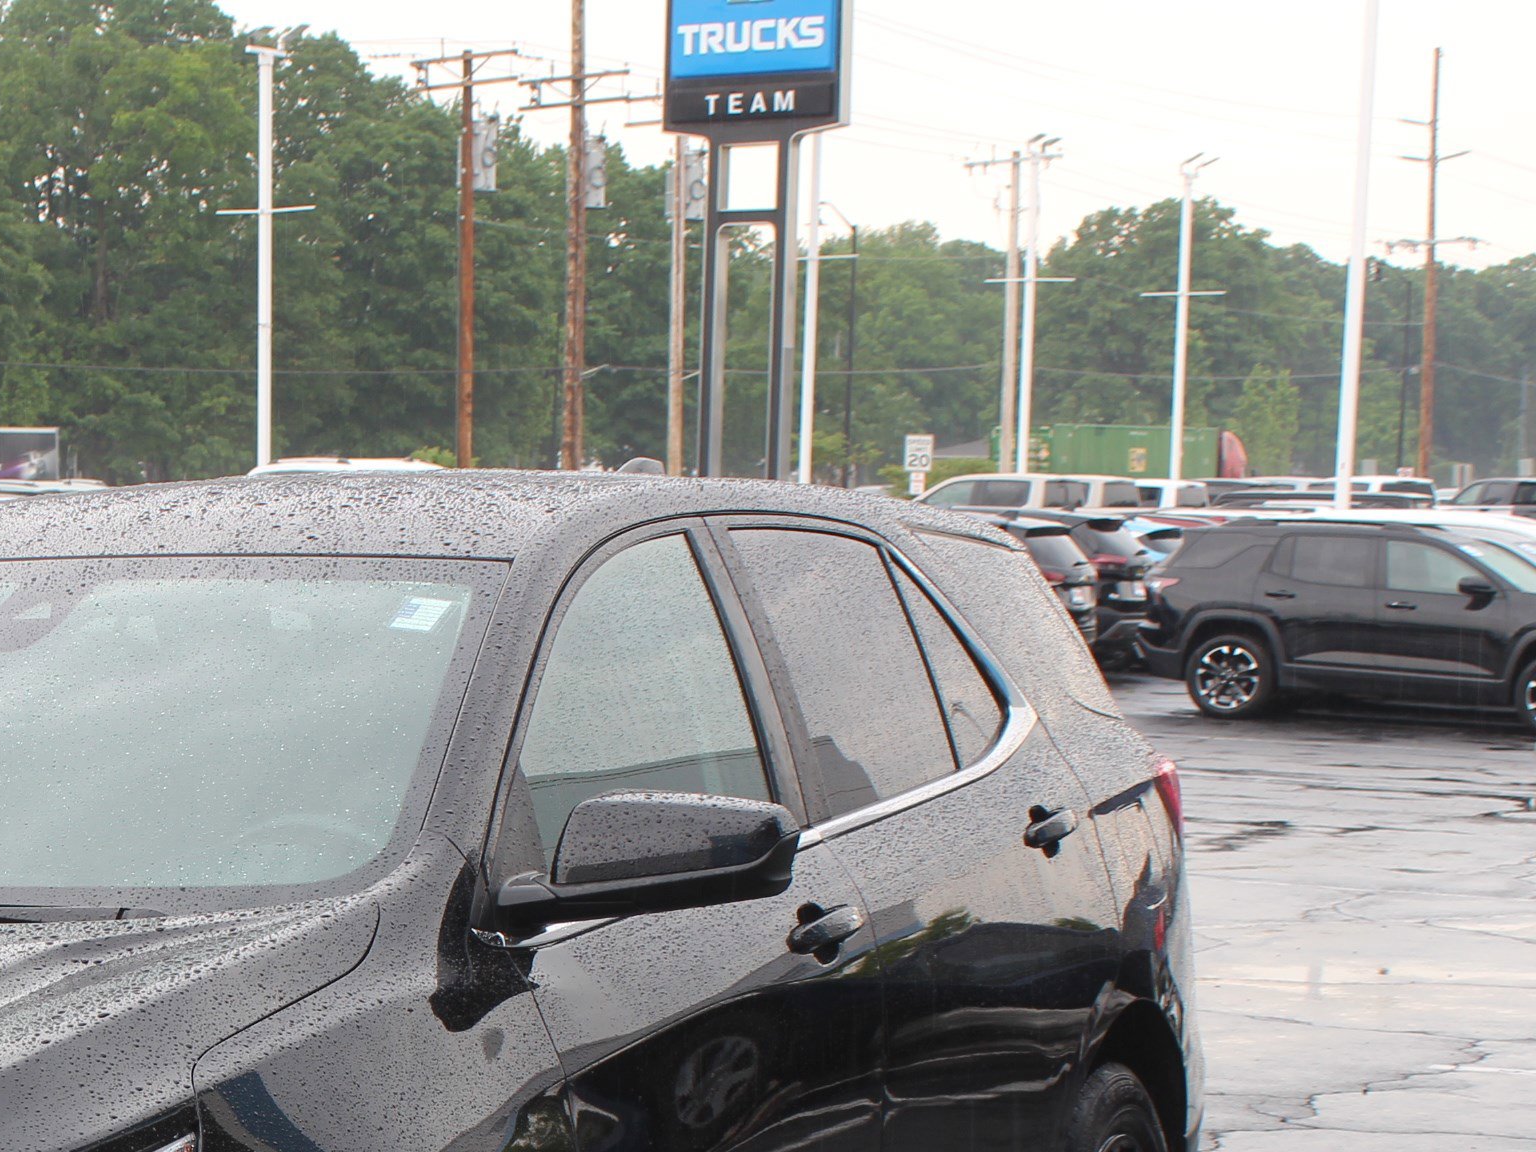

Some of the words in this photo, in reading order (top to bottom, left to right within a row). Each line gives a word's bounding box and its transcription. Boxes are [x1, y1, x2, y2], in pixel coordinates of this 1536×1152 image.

[677, 15, 825, 56] TRUCKS
[704, 89, 796, 116] TEAM
[908, 453, 931, 467] 20
